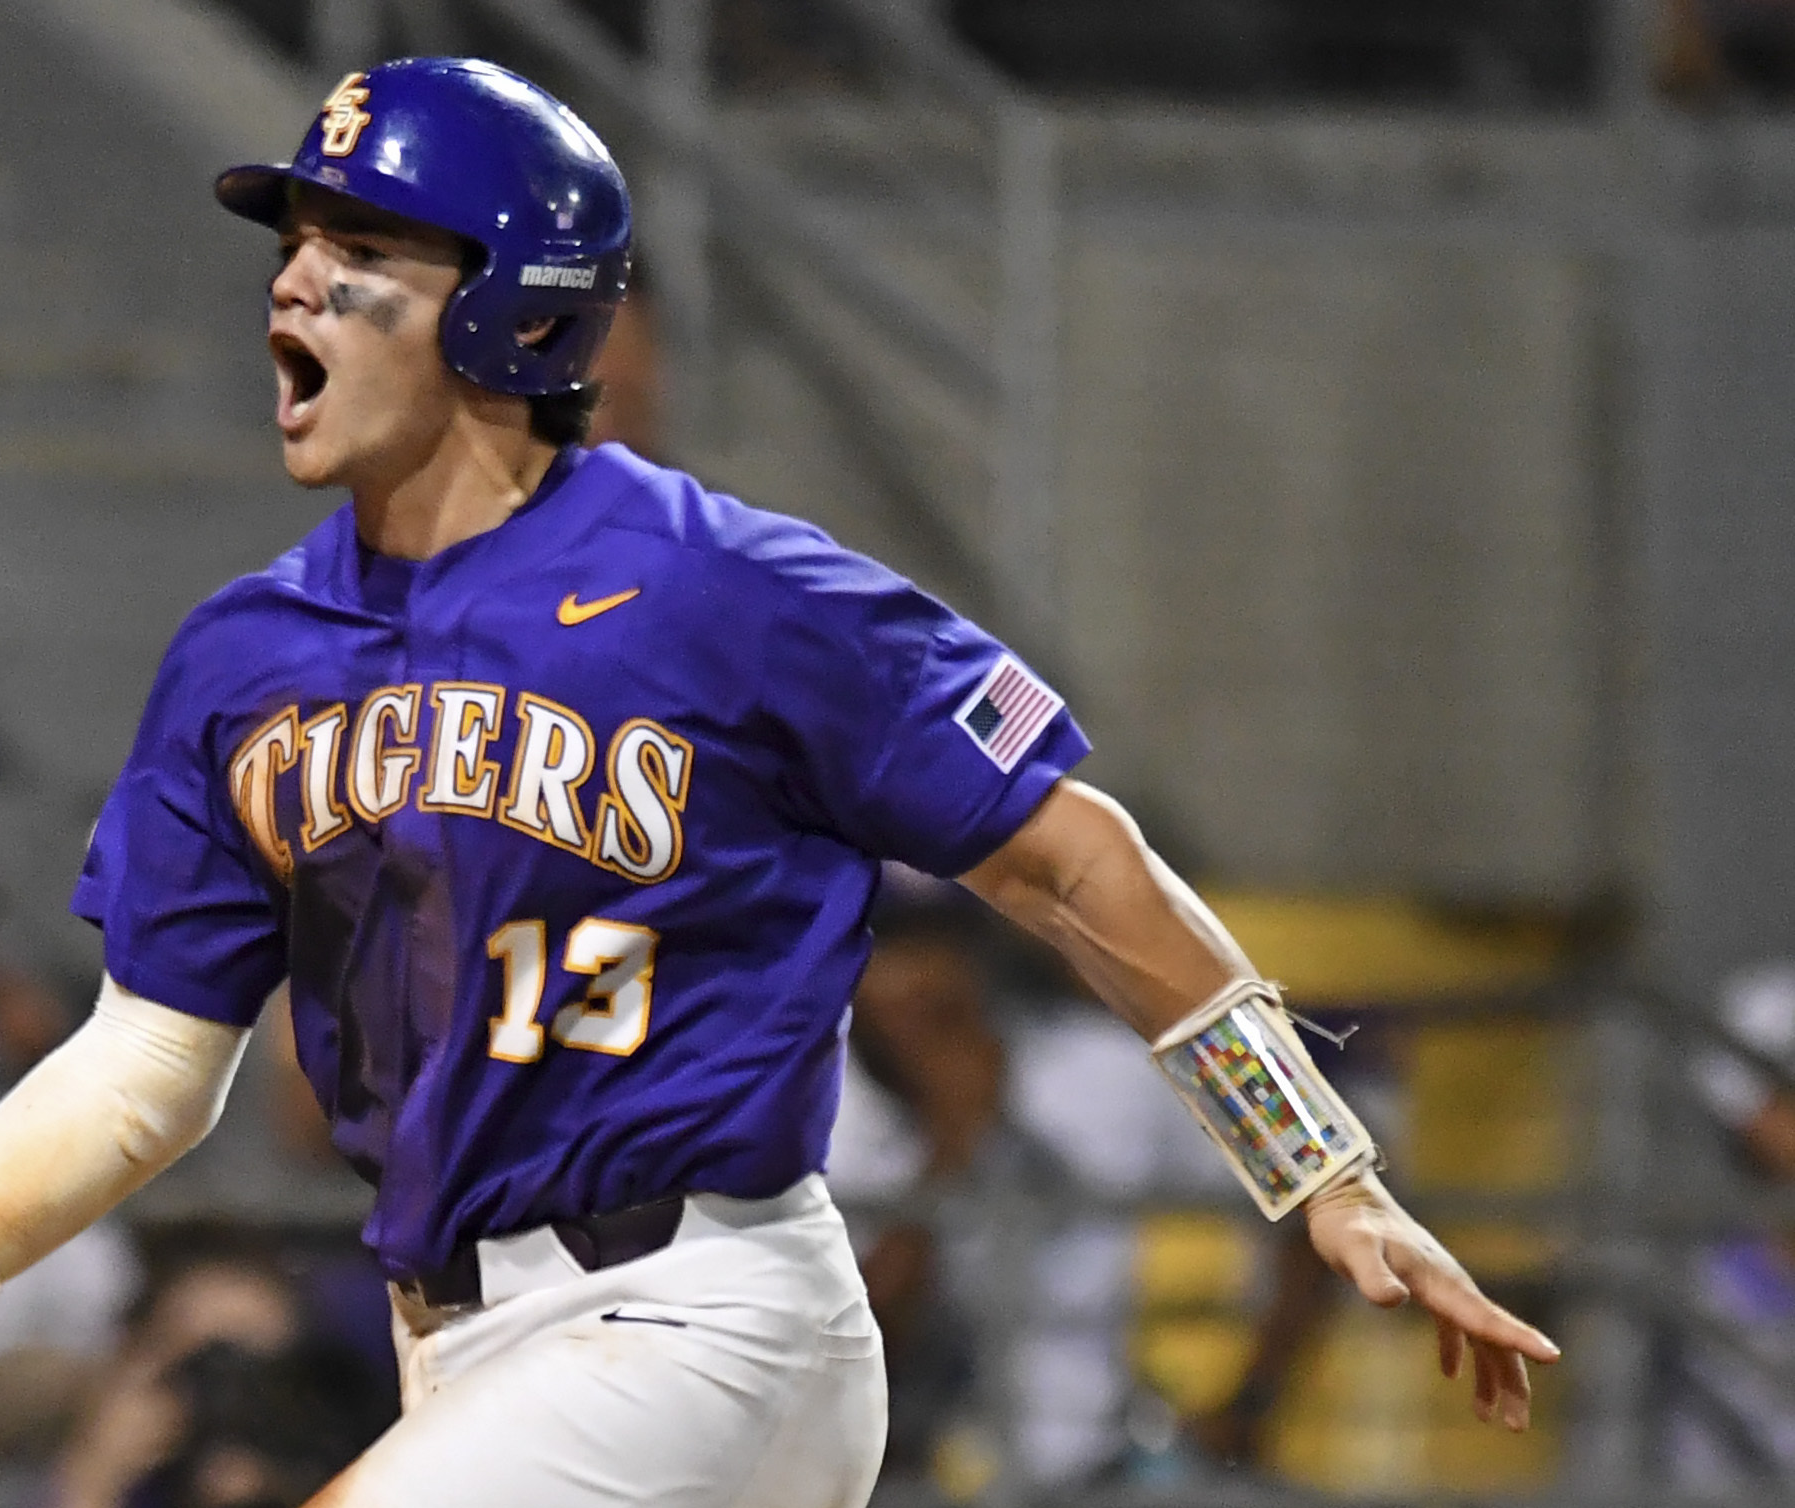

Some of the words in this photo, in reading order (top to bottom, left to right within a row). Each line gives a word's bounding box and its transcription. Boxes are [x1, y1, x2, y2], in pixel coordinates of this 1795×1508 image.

[519, 264, 597, 290] marucci
[230, 681, 694, 886] TIGERS
[487, 917, 660, 1064] 13
